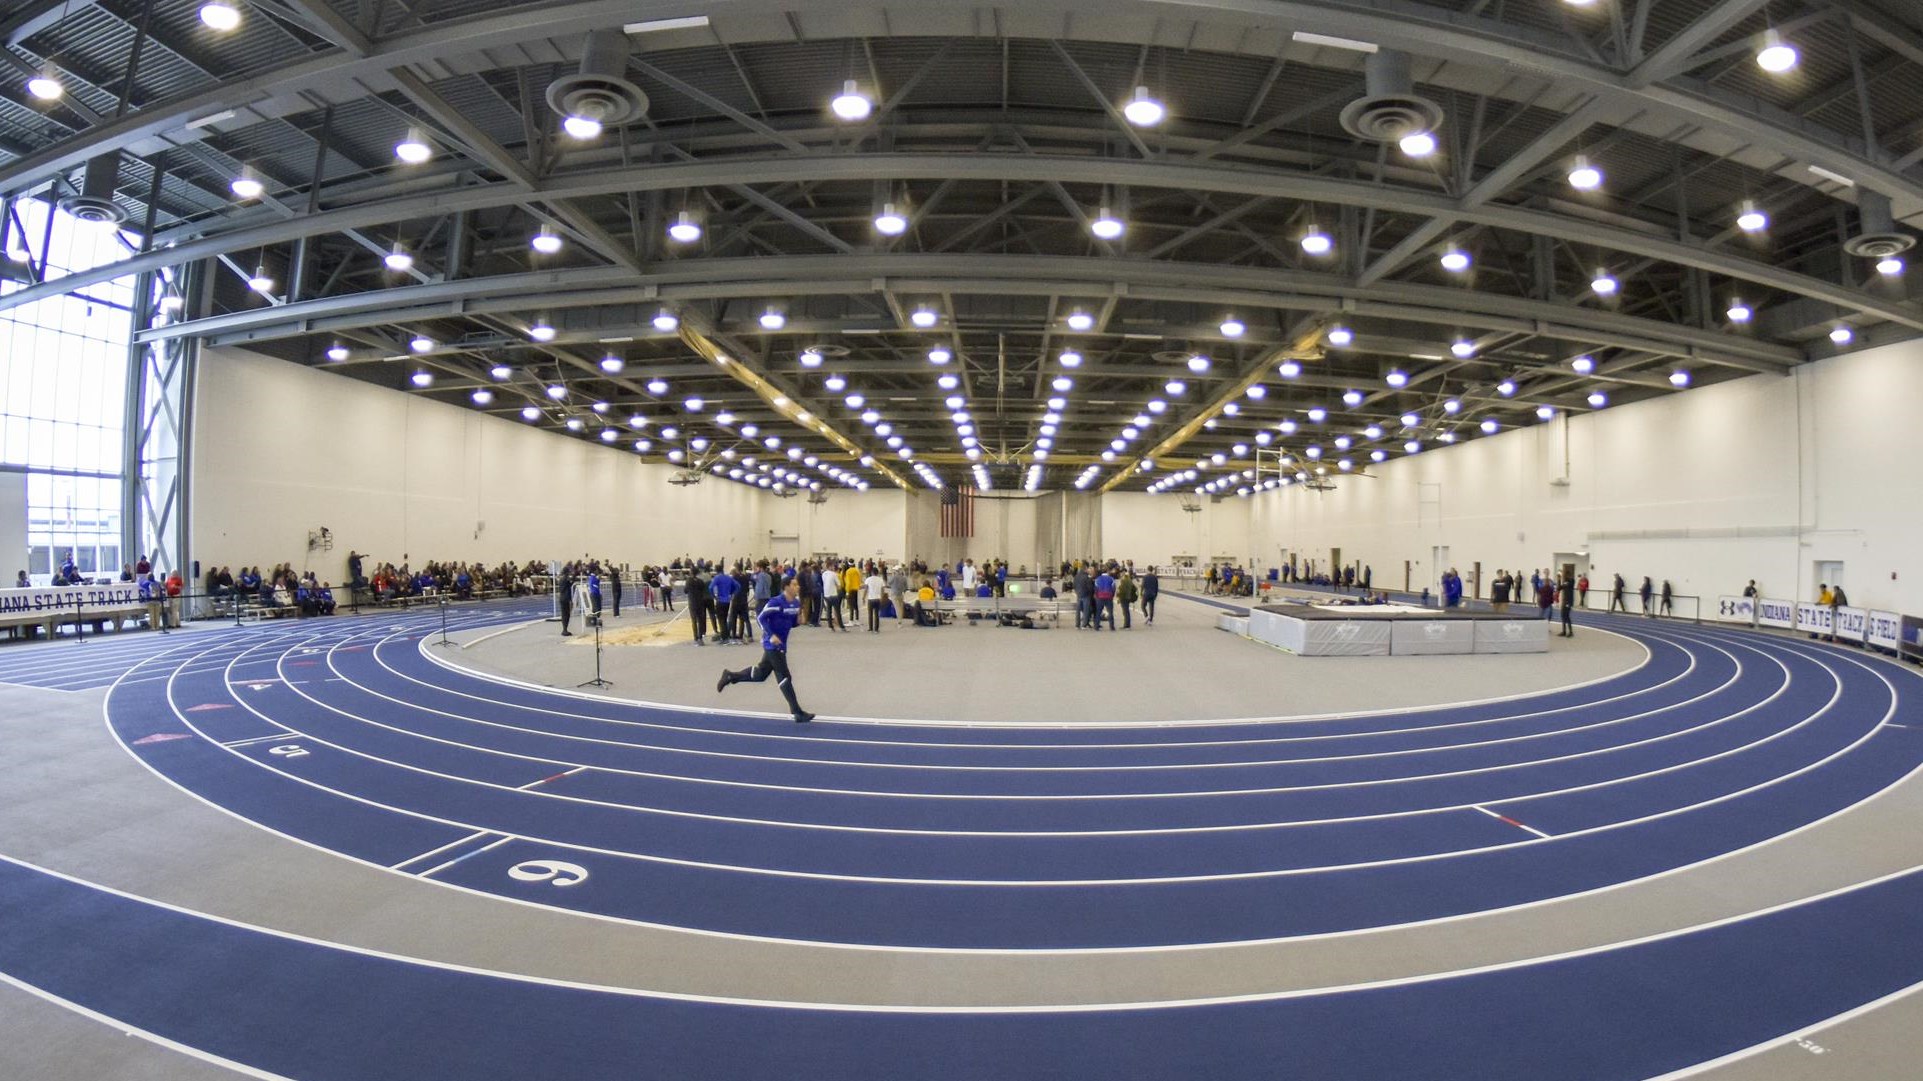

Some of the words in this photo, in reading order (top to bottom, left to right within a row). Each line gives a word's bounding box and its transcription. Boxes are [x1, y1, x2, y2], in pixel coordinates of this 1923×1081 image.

[34, 592, 84, 611] STATE
[88, 590, 132, 607] TRACK
[1759, 604, 1791, 622] INDIANA
[1798, 608, 1831, 628] STATE
[1837, 612, 1864, 632] TRACK
[1875, 618, 1897, 640] FIELD
[269, 744, 309, 757] 5
[508, 860, 588, 886] 6
